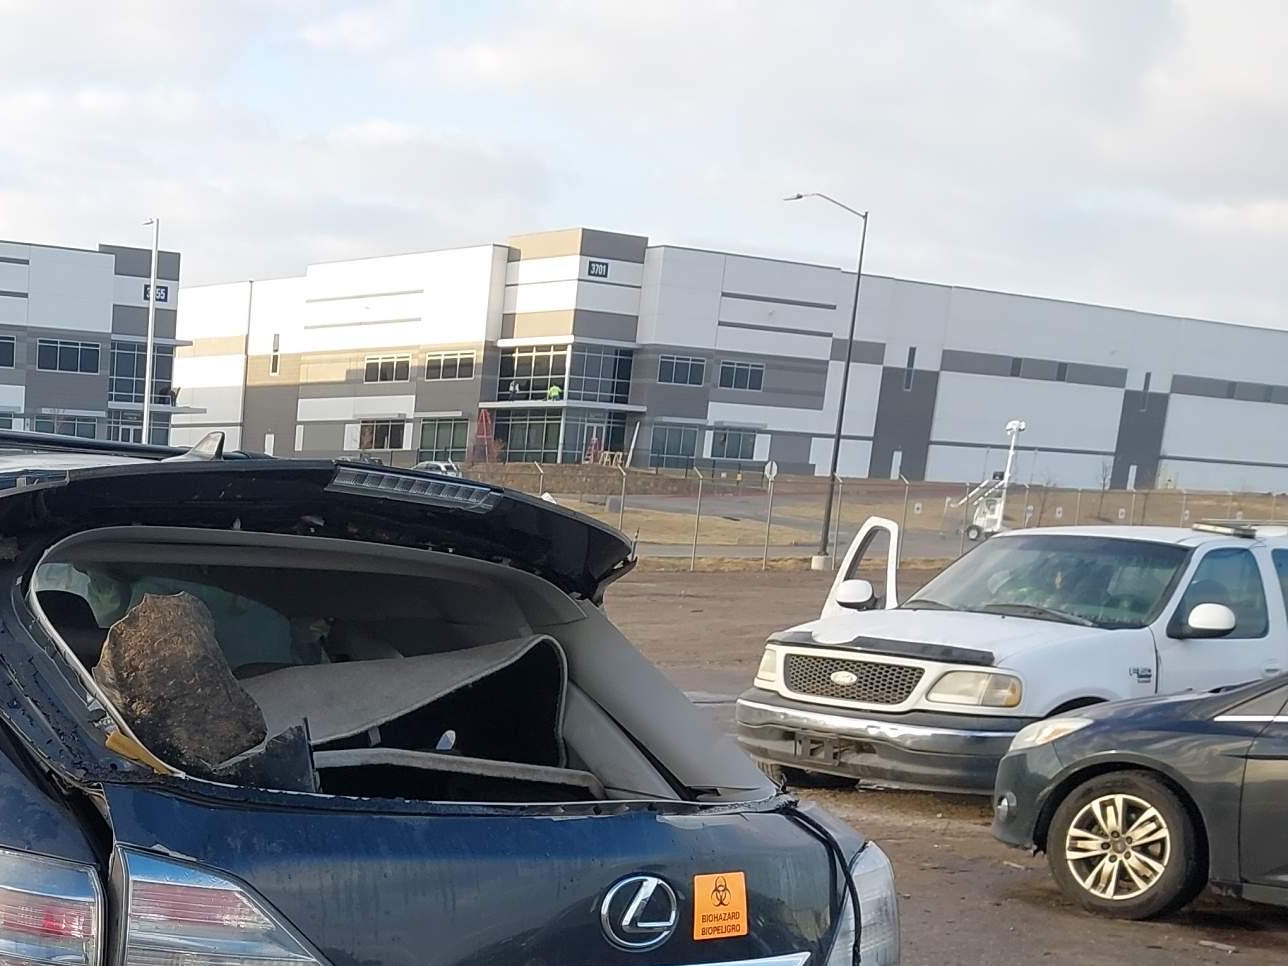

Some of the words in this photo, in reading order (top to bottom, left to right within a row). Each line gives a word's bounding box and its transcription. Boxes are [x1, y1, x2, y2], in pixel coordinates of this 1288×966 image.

[590, 263, 607, 276] 3701
[701, 911, 740, 923] BIOHAZARD
[701, 924, 741, 936] BIOPELIGRO
